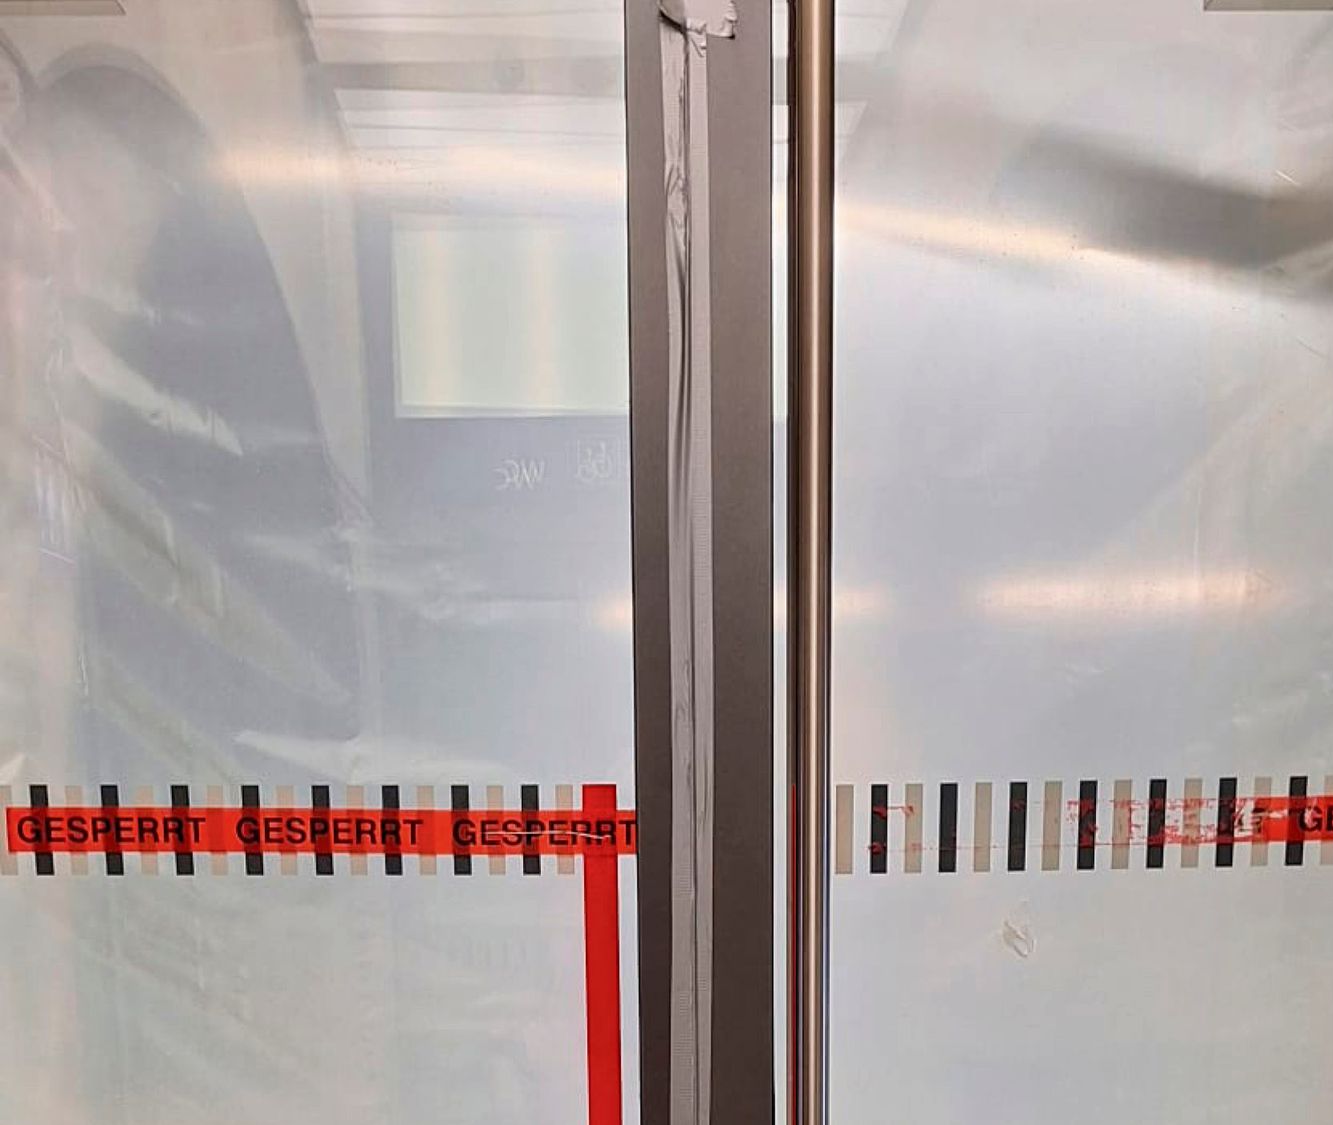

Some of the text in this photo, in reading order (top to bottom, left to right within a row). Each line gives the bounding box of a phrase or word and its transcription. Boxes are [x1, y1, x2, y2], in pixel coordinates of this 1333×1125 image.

[16, 815, 636, 847] GESPERRT GESPERRT GESPERRT
